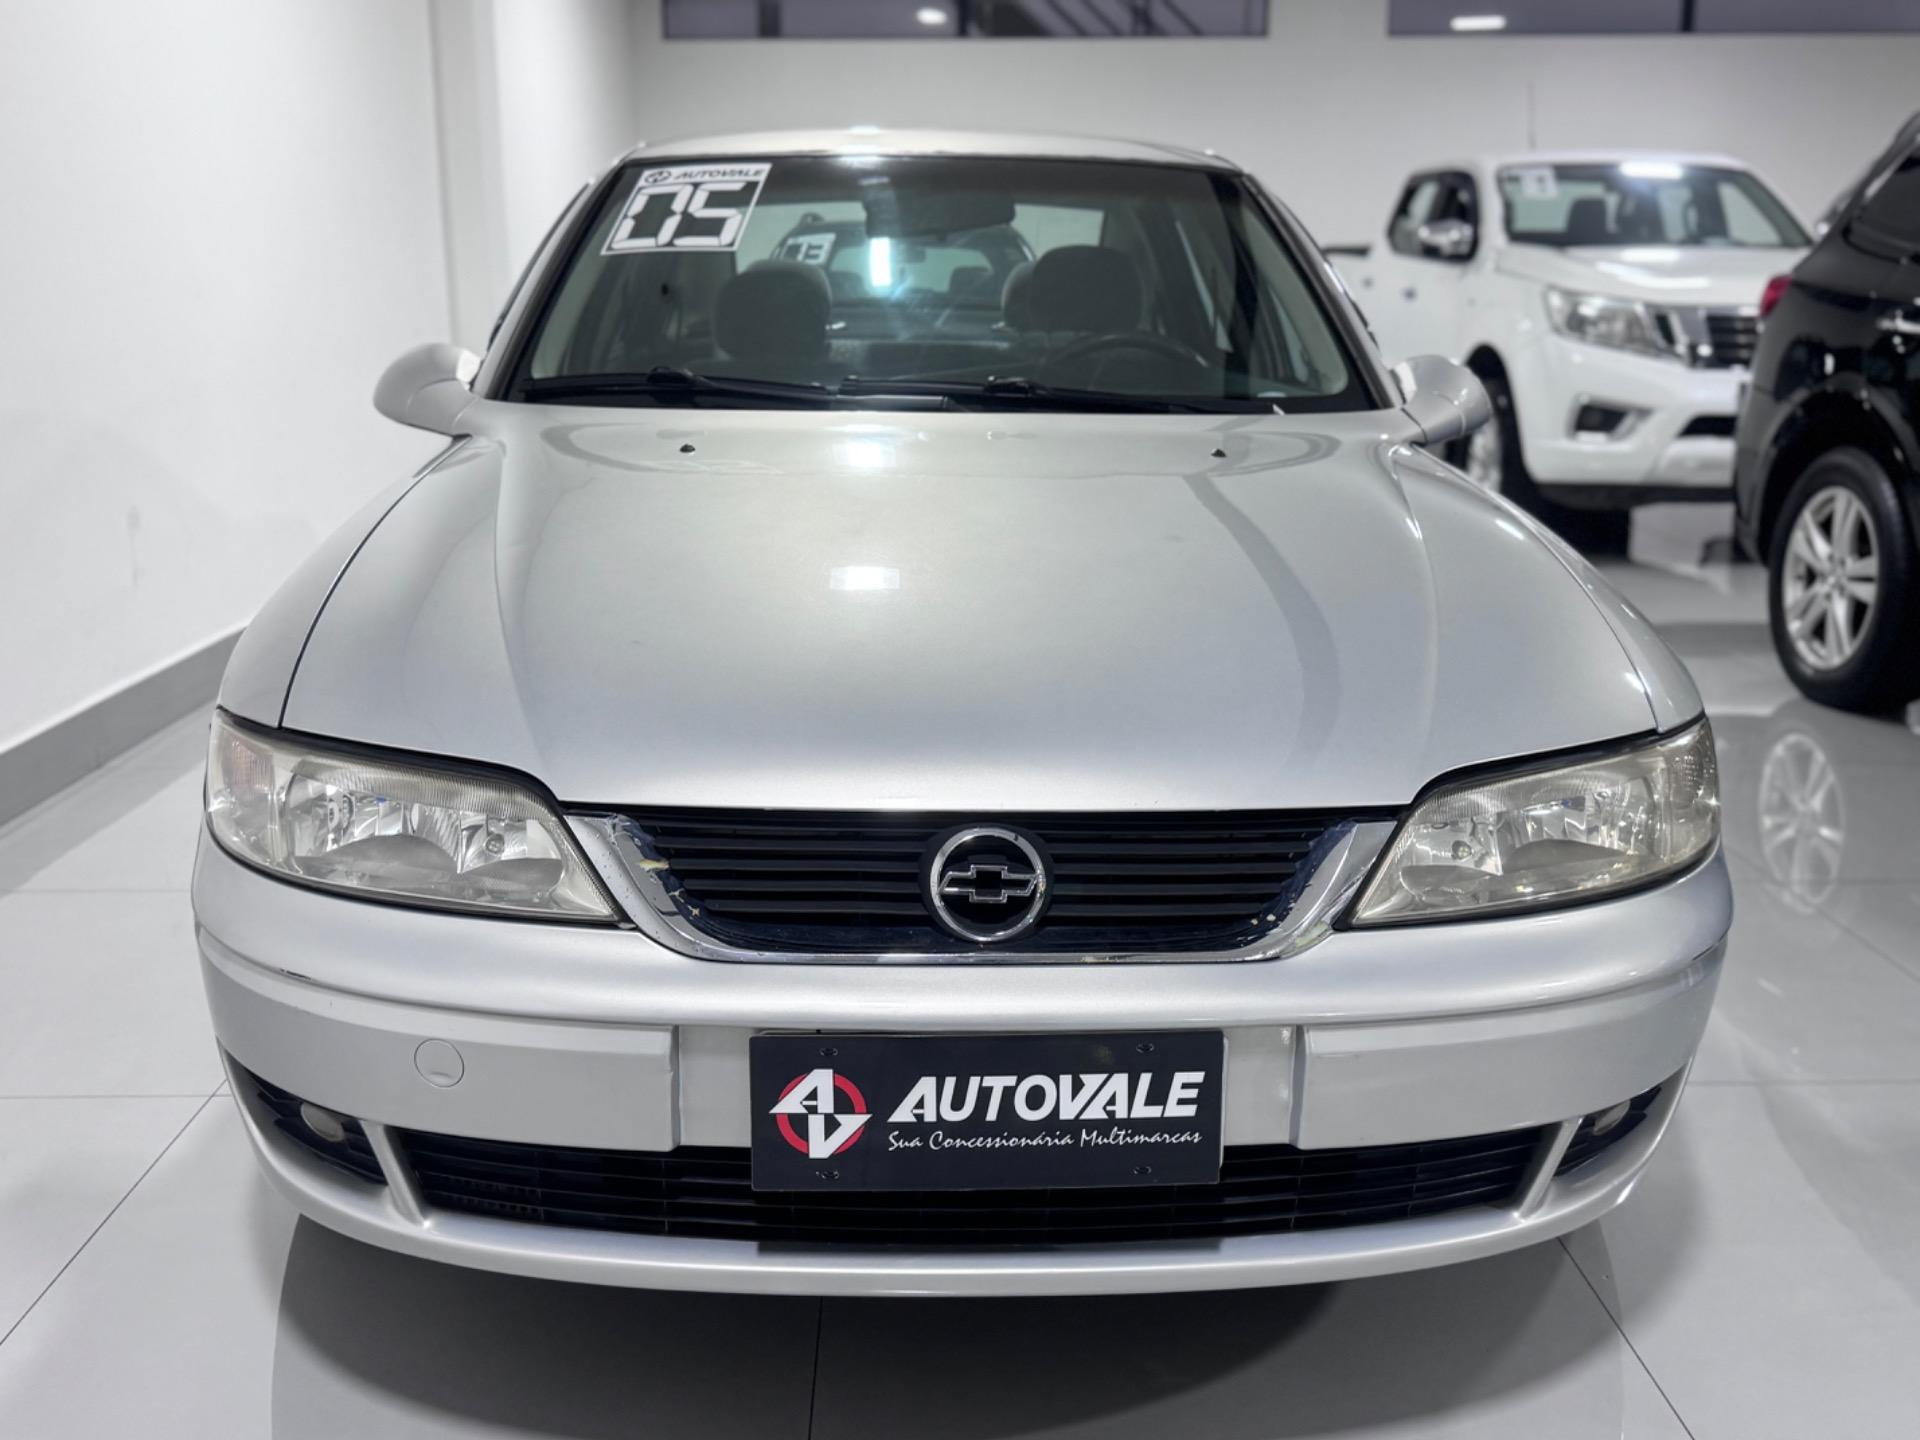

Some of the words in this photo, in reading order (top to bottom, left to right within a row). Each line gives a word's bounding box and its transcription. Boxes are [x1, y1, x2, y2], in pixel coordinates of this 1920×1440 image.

[611, 182, 748, 250] 05
[887, 1071, 1206, 1123] AUTOVALE
[887, 1130, 924, 1152] Sua
[928, 1130, 1076, 1151] Concessionária
[1079, 1125, 1204, 1149] Multimarcas
